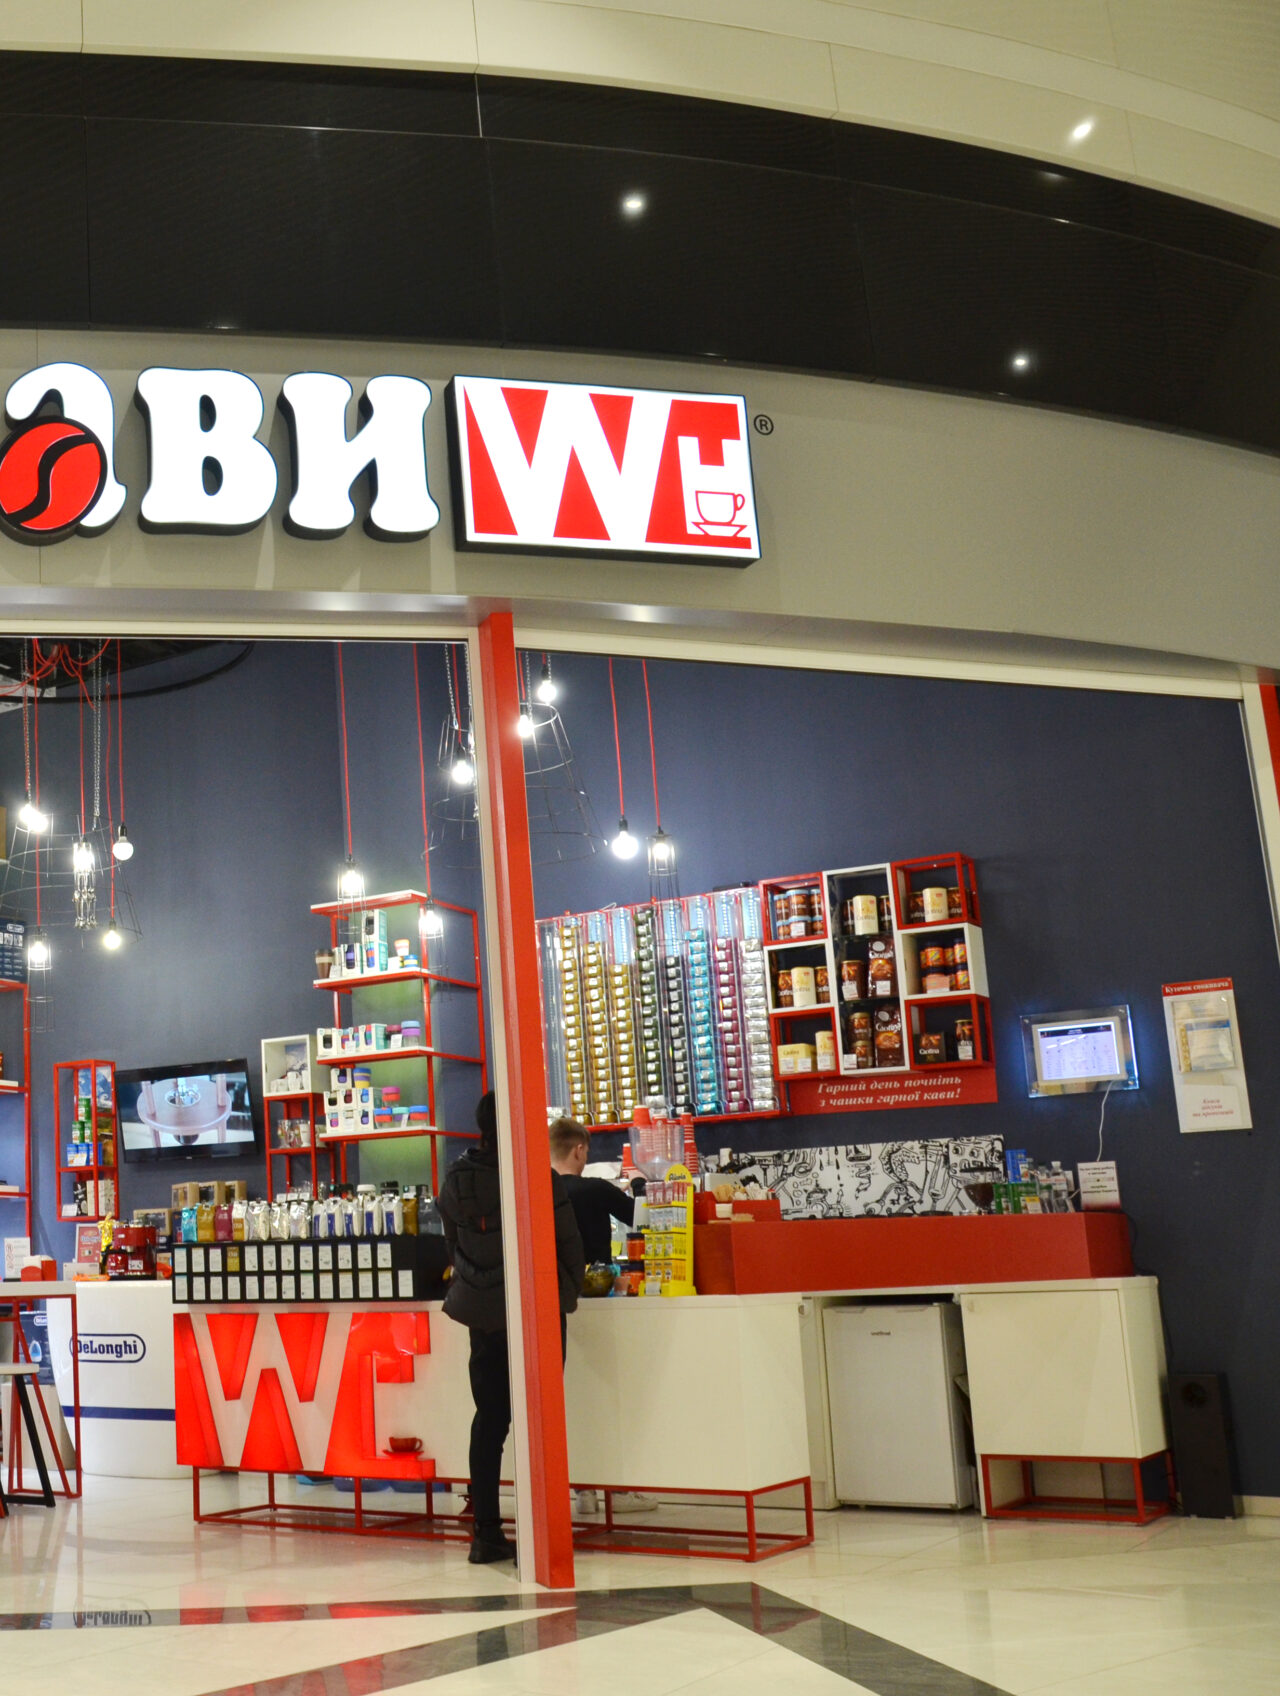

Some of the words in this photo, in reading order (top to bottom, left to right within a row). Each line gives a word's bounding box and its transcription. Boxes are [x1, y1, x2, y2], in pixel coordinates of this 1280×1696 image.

[817, 1080, 866, 1095] Гарний
[869, 1079, 900, 1090] день
[904, 1075, 962, 1087] почніть
[829, 1097, 874, 1106] чашки
[876, 1091, 920, 1105] гарної
[923, 1088, 961, 1100] кави!
